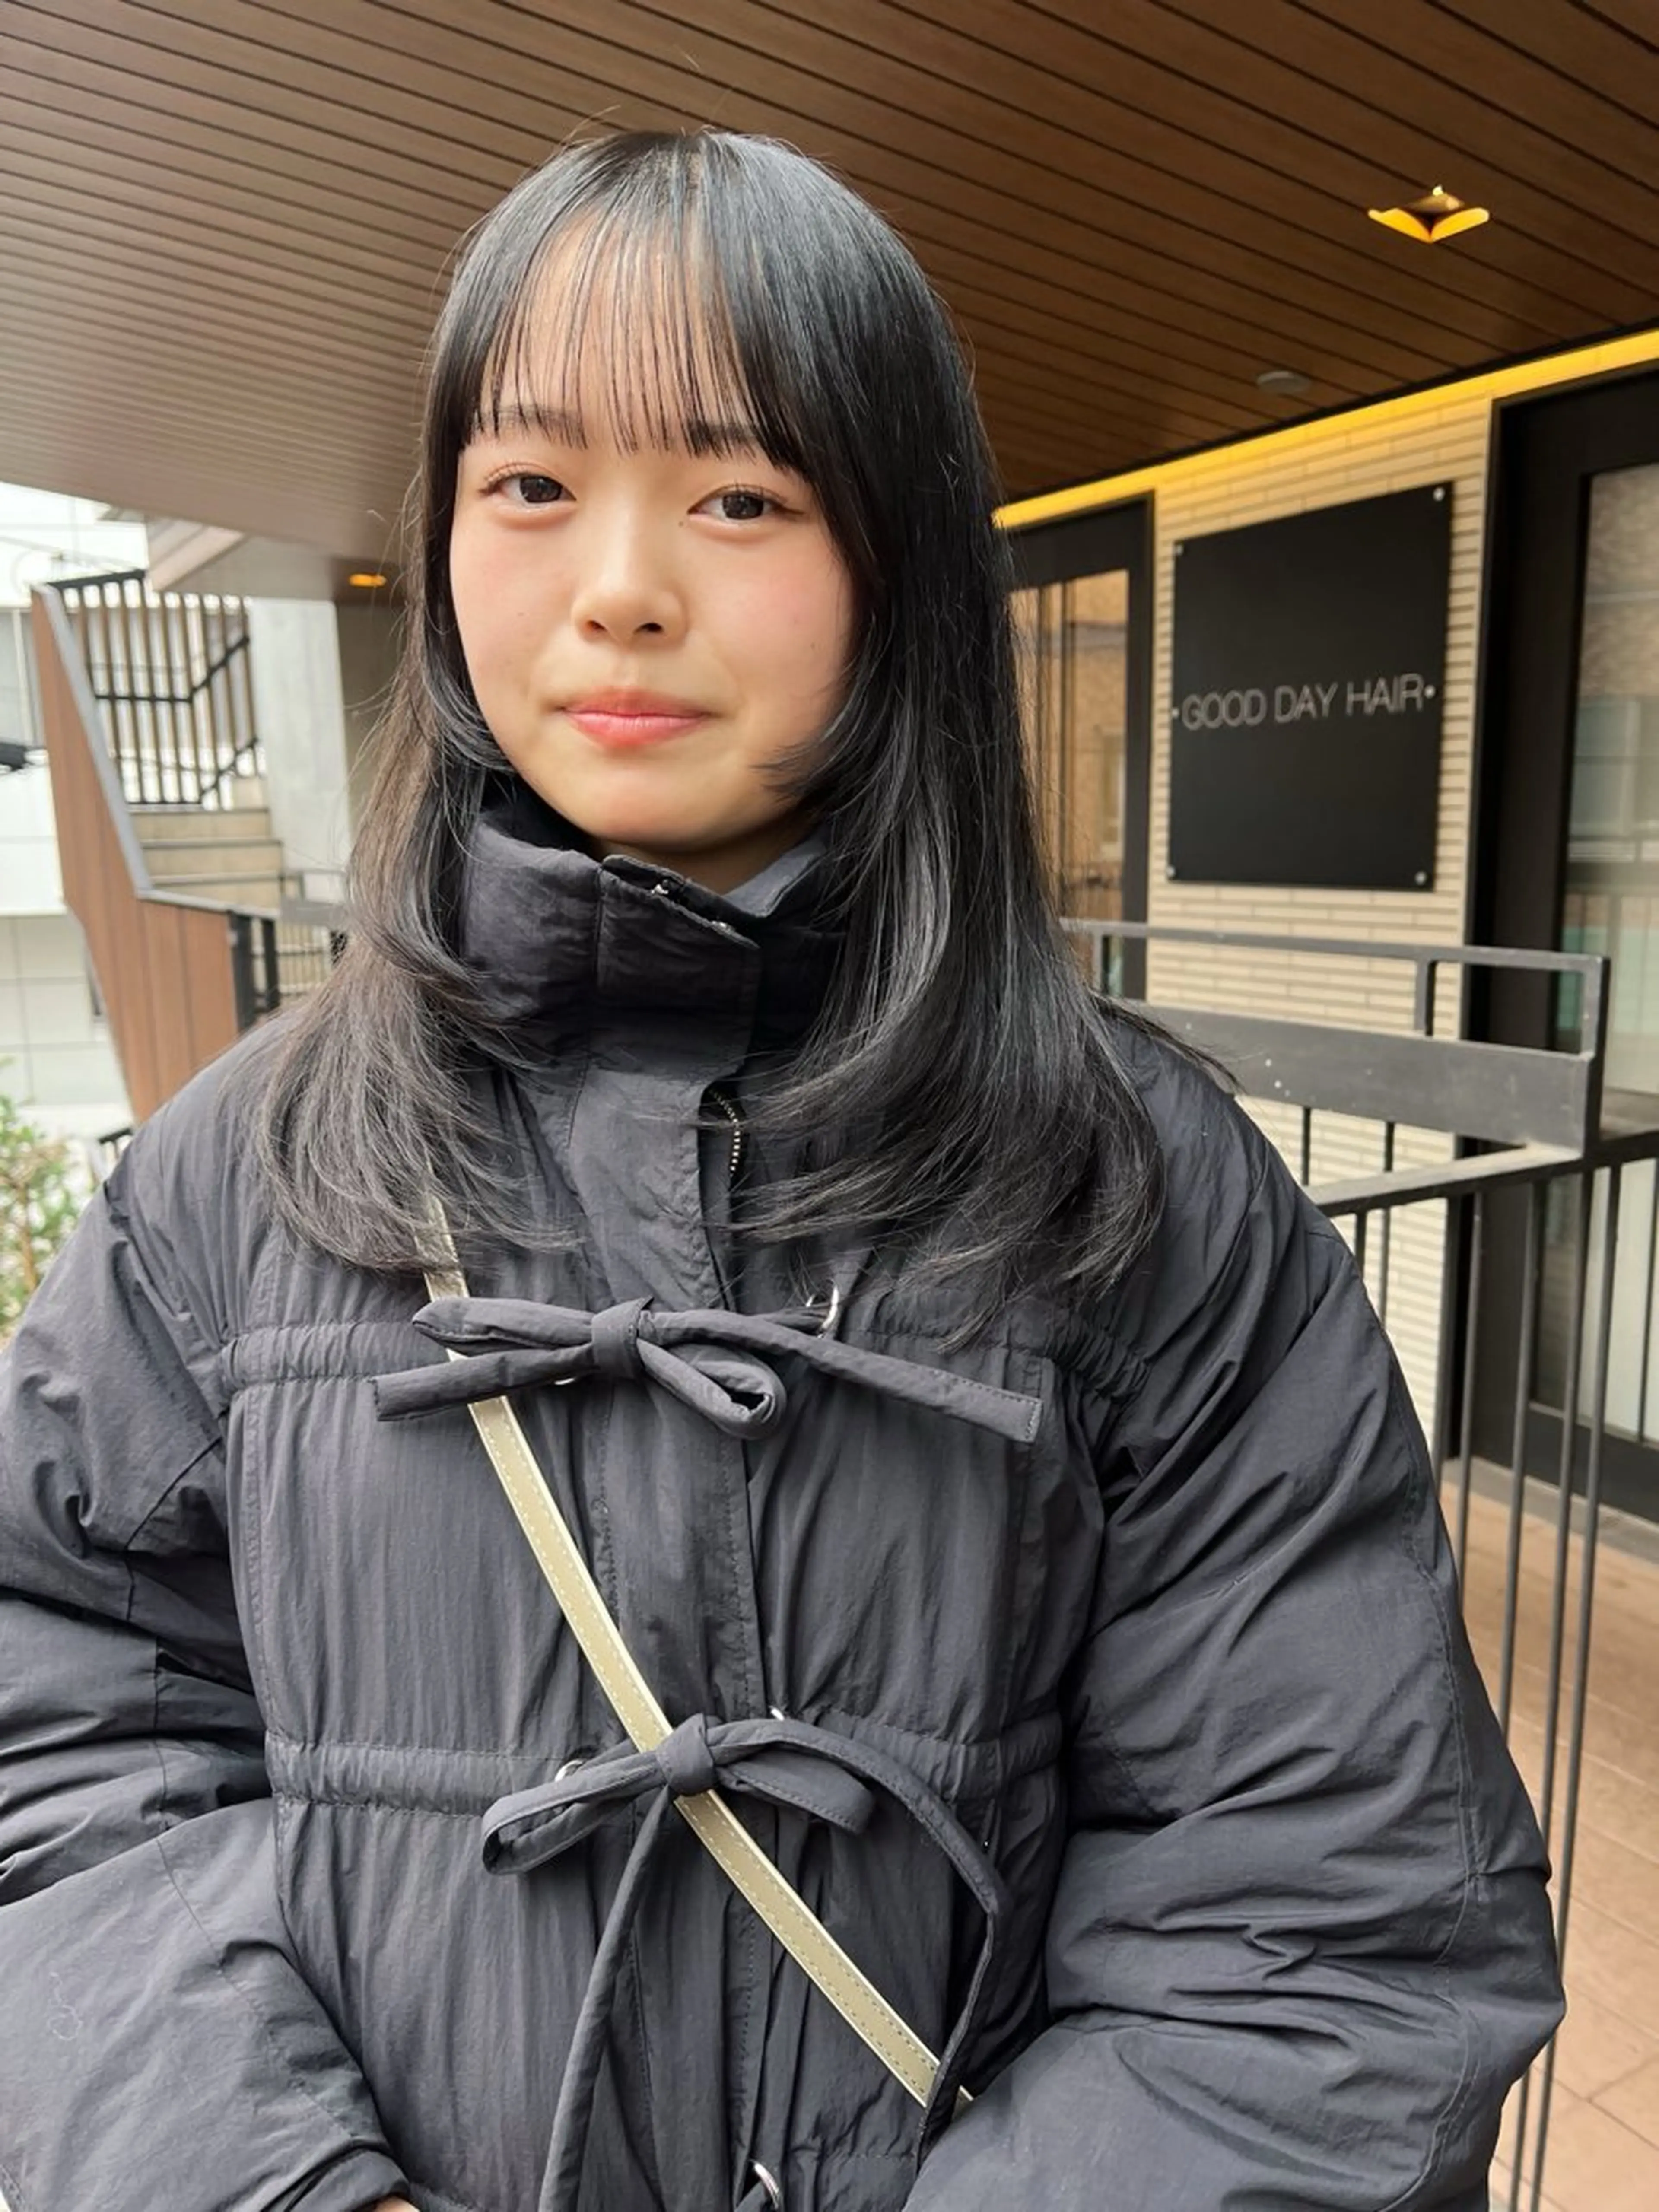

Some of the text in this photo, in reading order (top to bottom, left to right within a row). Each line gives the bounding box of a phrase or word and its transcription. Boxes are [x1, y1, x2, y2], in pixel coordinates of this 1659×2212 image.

[1182, 673, 1423, 730] GOOD DAY HAIR
